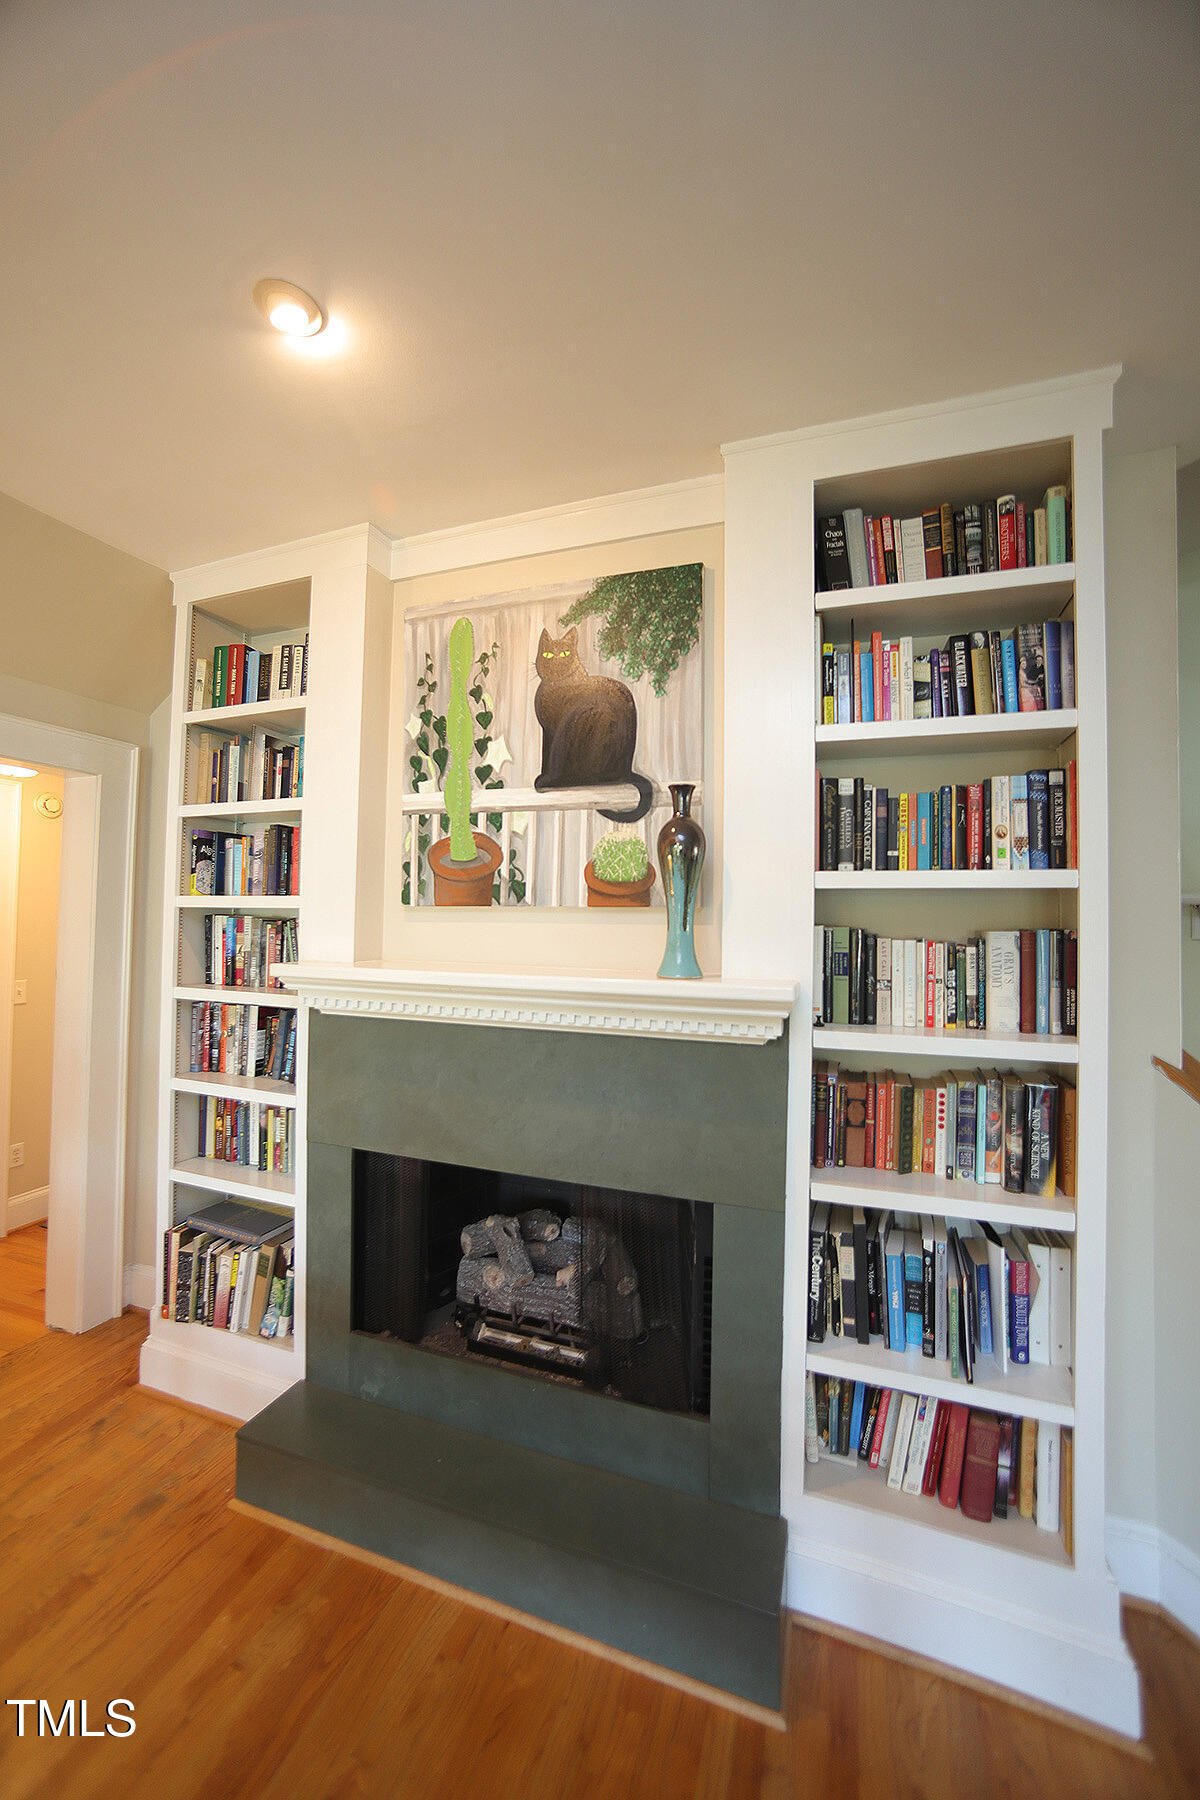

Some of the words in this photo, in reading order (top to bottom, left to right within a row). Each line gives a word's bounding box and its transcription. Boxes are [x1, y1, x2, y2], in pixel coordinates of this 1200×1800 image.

[825, 530, 843, 538] Chaos
[826, 540, 844, 549] Fractals
[1000, 517, 1010, 561] BROTHERS
[954, 640, 967, 689] BLACKWATER
[1054, 792, 1064, 805] ICE
[845, 808, 853, 848] GALILEO'S
[1054, 806, 1064, 836] MASTER
[948, 969, 956, 987] BIG
[991, 947, 1002, 989] ANATOMY
[1004, 951, 1014, 984] GRAY'S
[1031, 1108, 1041, 1130] KIND
[1031, 1131, 1041, 1144] OF
[1040, 1140, 1050, 1160] NEW
[1031, 1144, 1041, 1179] SCIENCE
[812, 1235, 823, 1255] The
[810, 1254, 823, 1301] Century
[1015, 1295, 1028, 1325] ABSOLUTE
[1015, 1326, 1028, 1348] POWER
